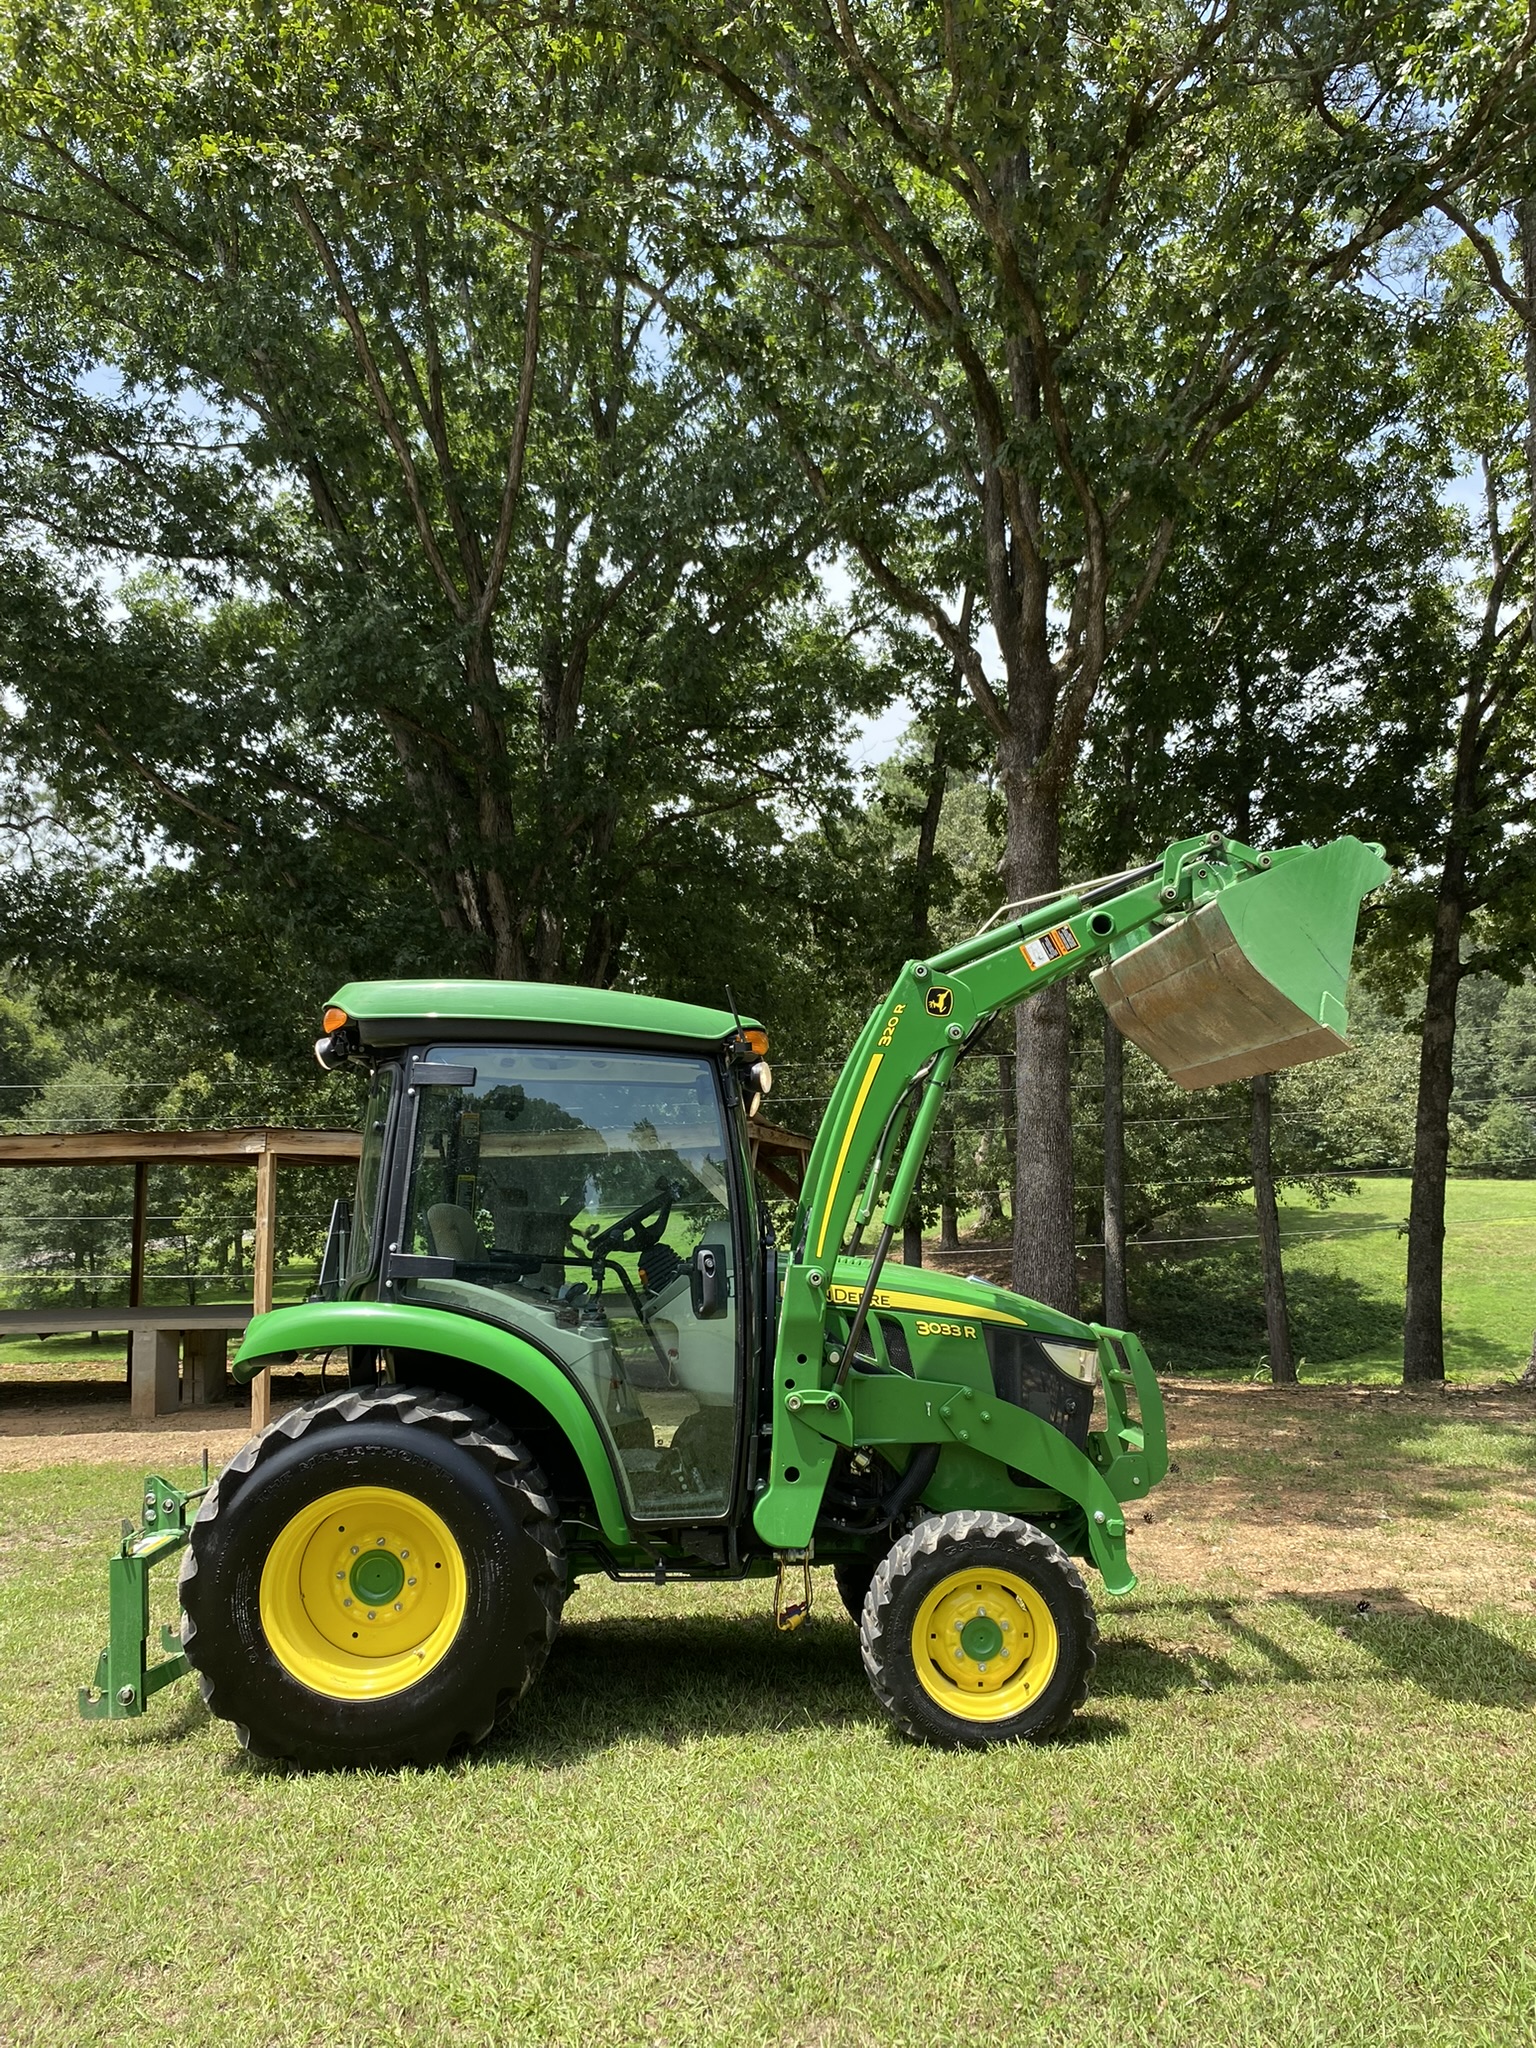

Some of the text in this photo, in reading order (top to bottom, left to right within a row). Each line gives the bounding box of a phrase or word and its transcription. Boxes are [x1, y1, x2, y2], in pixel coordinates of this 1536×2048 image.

[878, 1004, 906, 1046] 320 R
[916, 1321, 977, 1339] 3033 R
[298, 1446, 455, 1484] MARATHONER
[943, 1540, 1038, 1562] GALAXY
